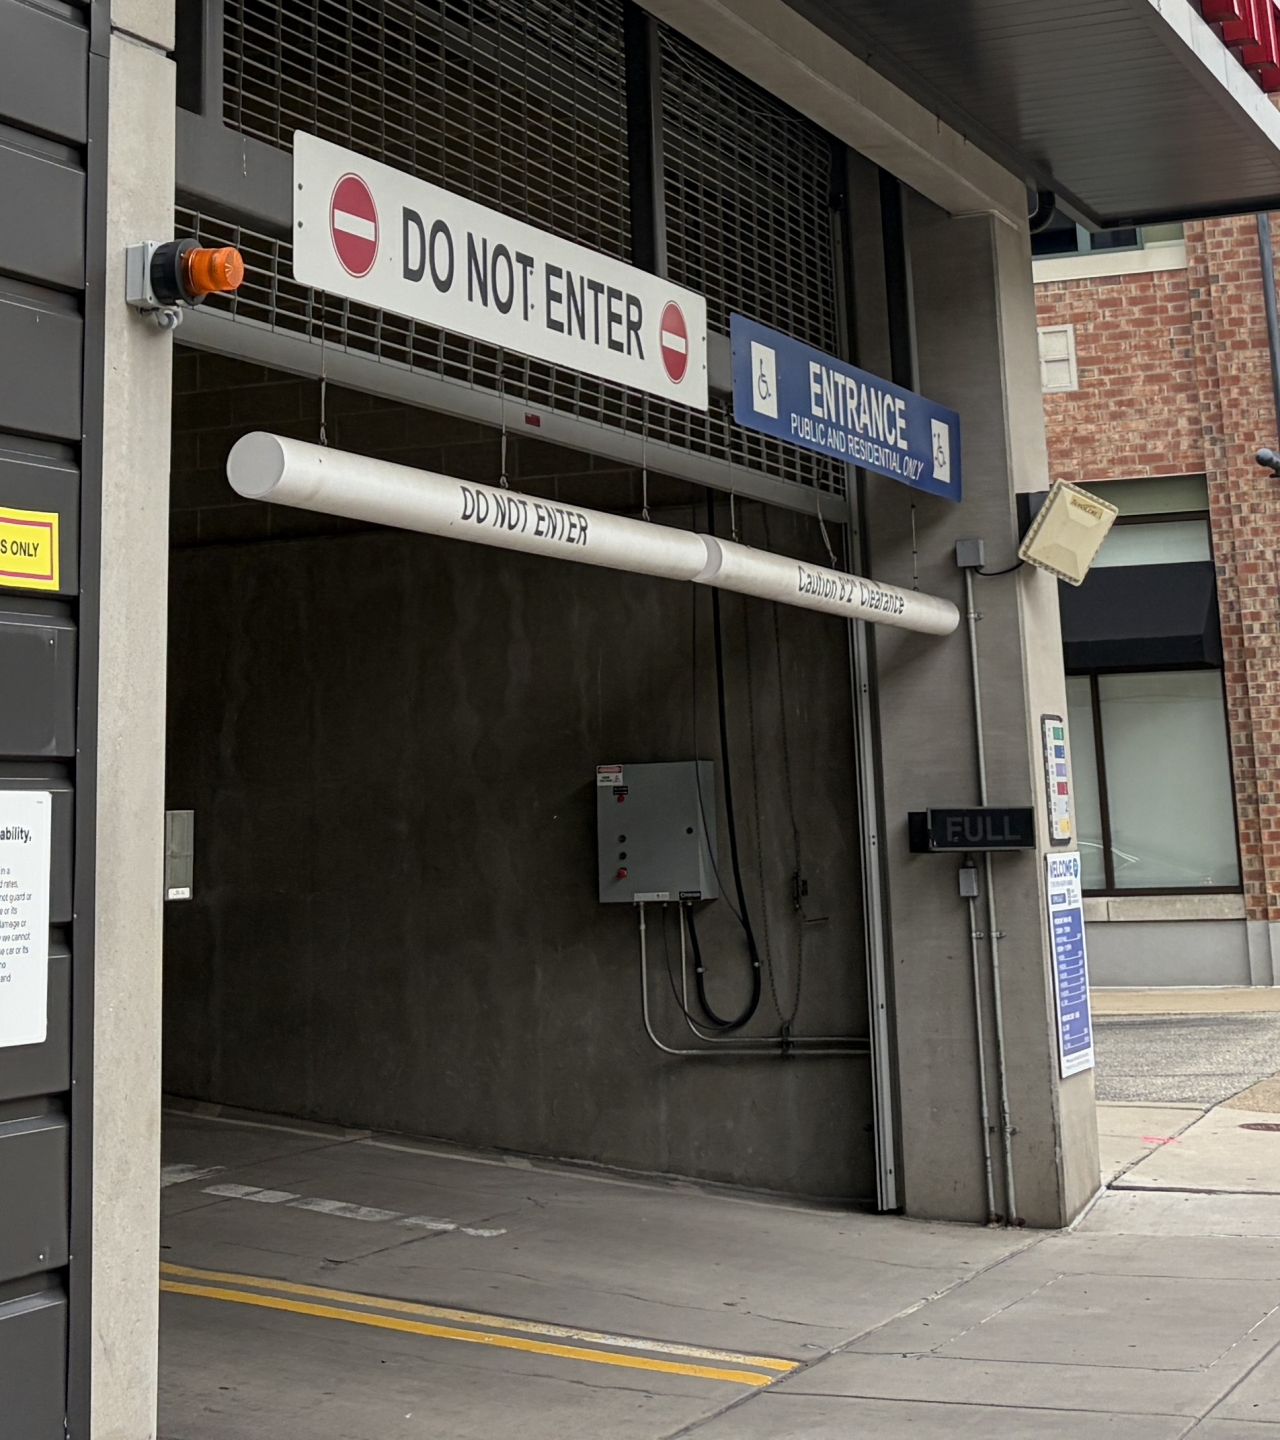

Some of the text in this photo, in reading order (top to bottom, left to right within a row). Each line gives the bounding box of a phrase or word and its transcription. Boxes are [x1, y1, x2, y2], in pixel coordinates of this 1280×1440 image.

[402, 205, 645, 360] DO NOT ENTER
[809, 361, 908, 450] ENTRANCE
[791, 413, 924, 480] PUBLIC AND RESIDENTIAL ONLY
[460, 485, 588, 546] DO NOT ENTER
[11, 541, 39, 557] ONLY
[798, 565, 837, 599] Caution
[859, 581, 904, 614] Clearance
[946, 815, 1020, 841] FULL
